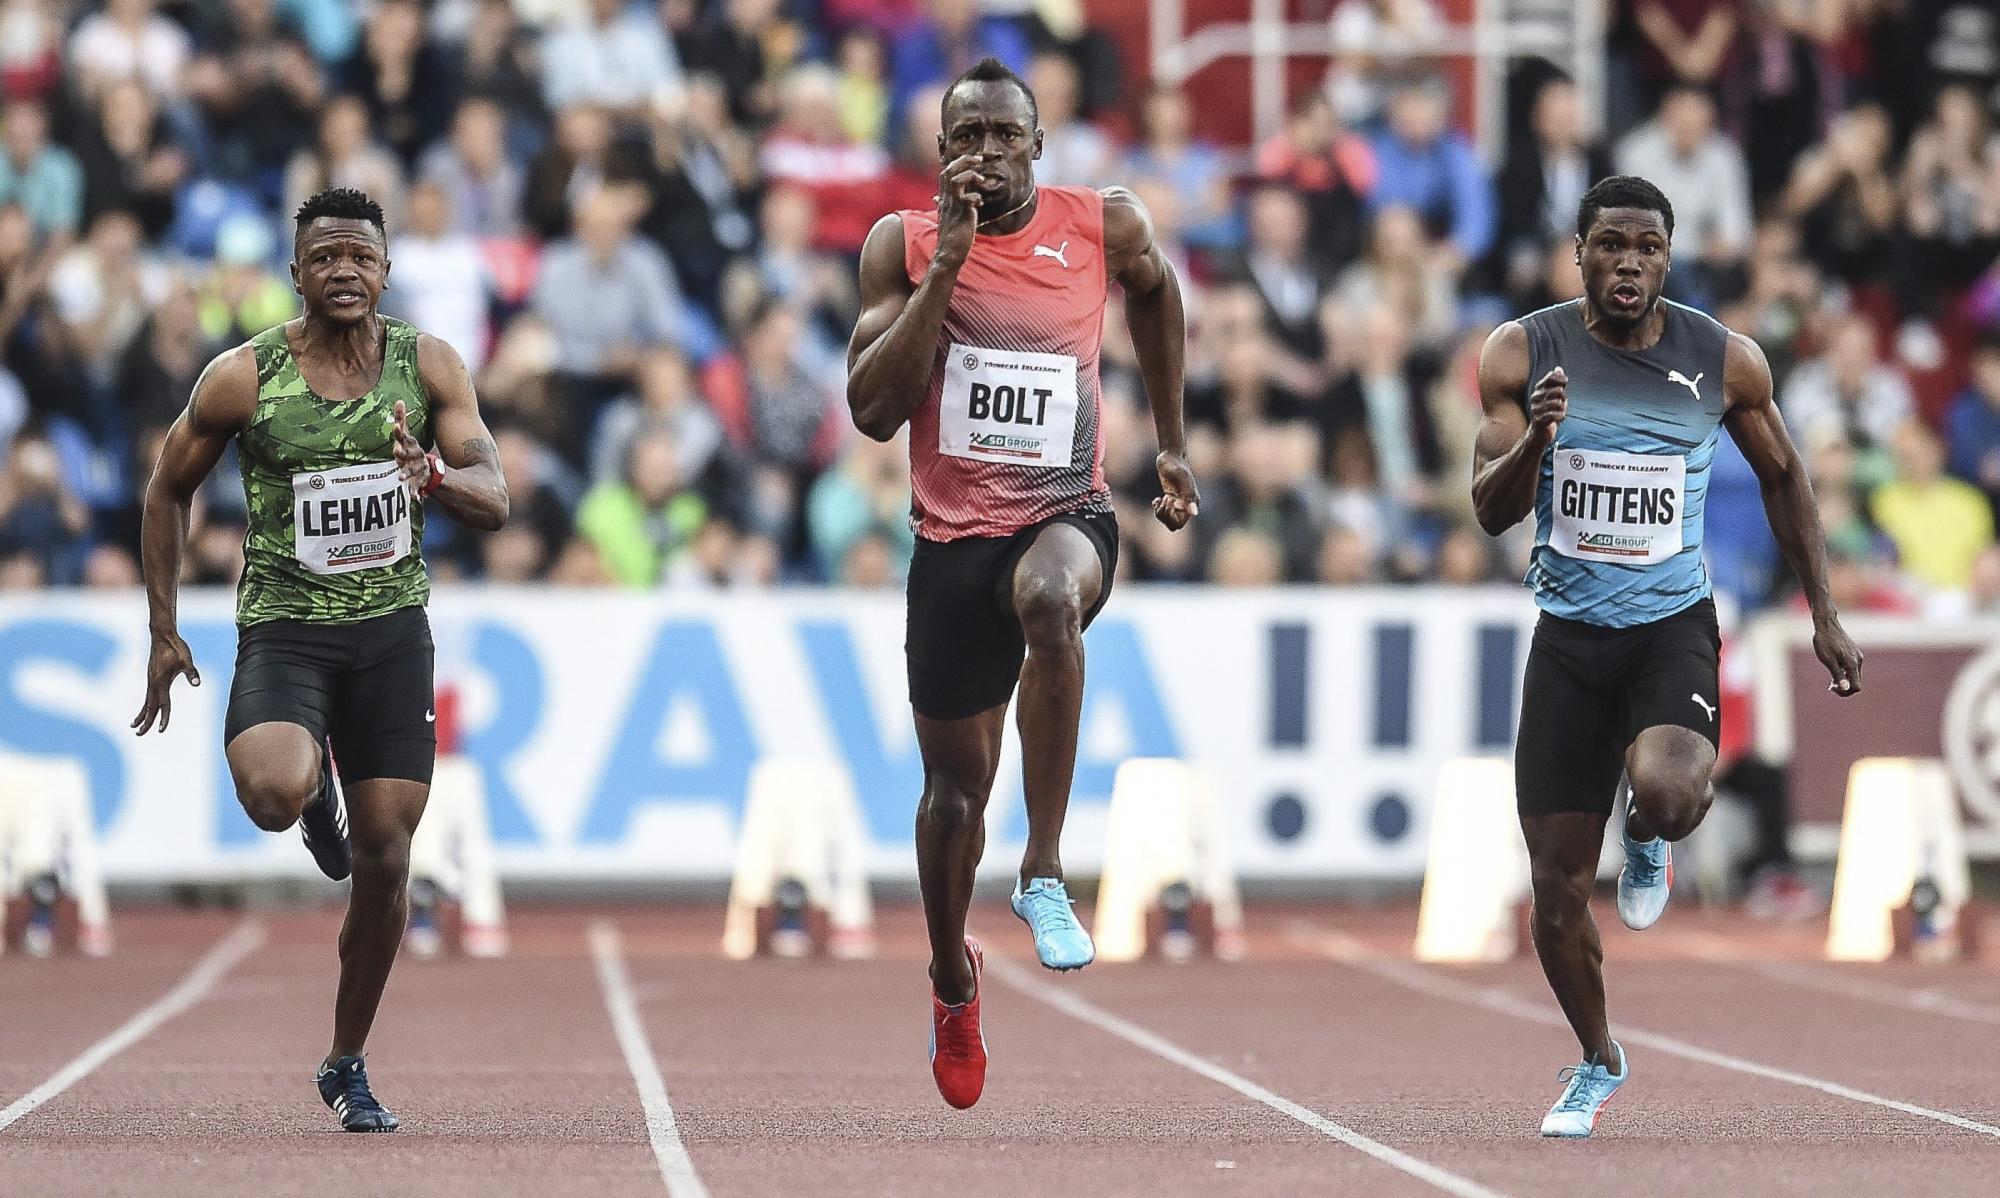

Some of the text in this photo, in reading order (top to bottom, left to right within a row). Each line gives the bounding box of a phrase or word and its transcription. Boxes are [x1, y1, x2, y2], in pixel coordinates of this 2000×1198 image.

[968, 382, 1053, 426] BOLT
[1007, 438, 1040, 449] GROUP
[302, 484, 407, 537] LEHATA
[1560, 478, 1676, 526] GITTENS
[363, 540, 393, 553] GROUP
[1614, 537, 1648, 547] GROUP
